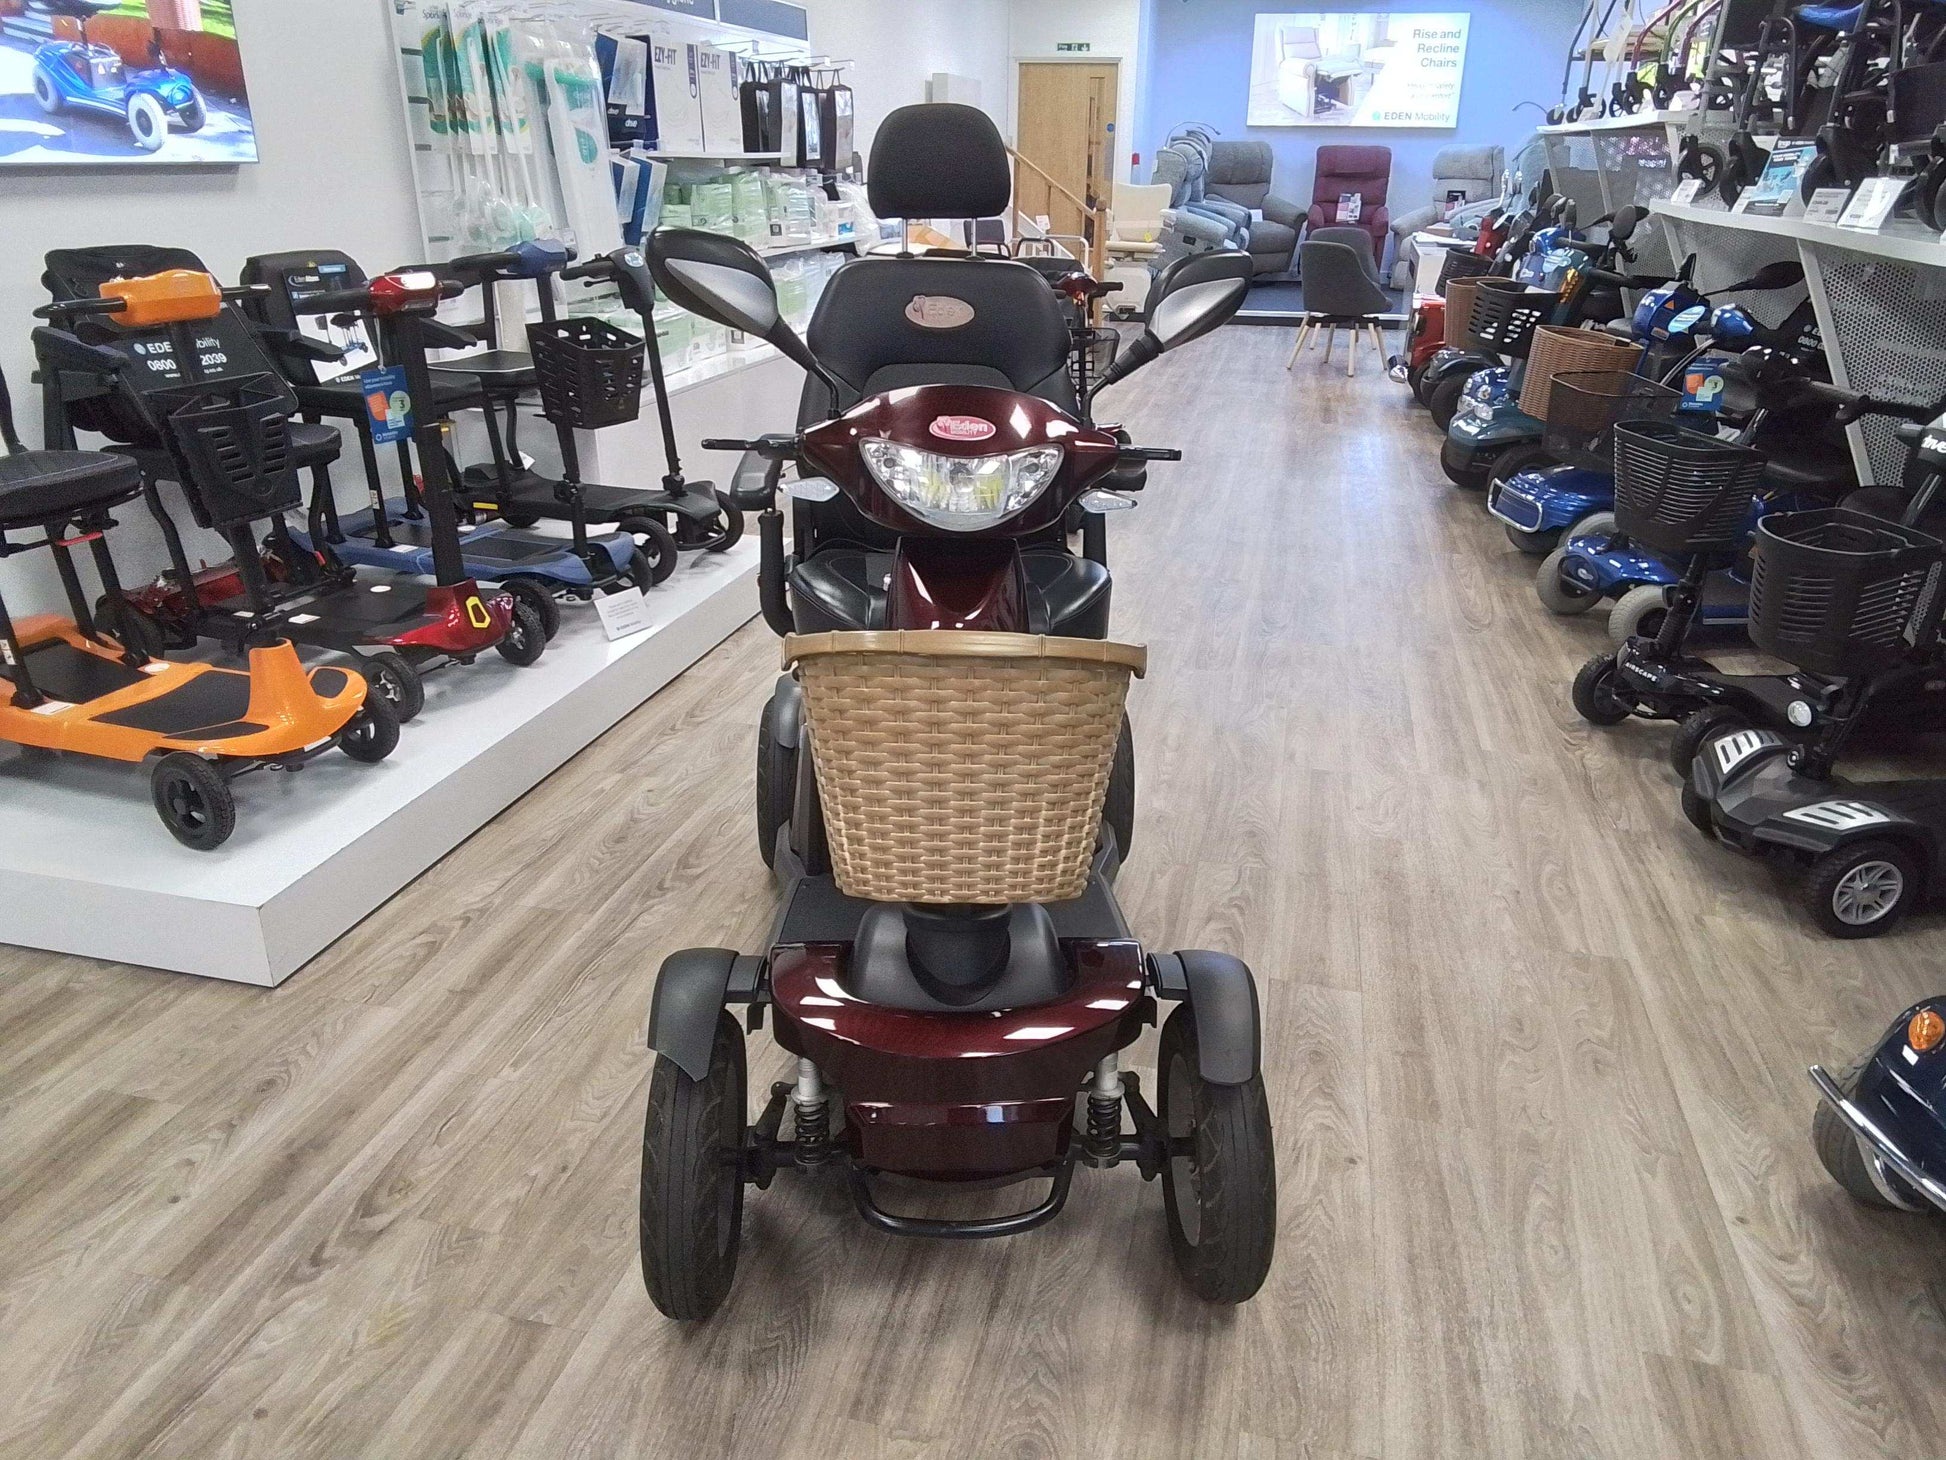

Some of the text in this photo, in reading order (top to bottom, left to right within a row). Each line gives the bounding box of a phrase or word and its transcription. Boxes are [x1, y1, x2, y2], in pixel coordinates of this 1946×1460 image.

[1412, 28, 1462, 39] Rise and
[1417, 43, 1460, 54] Recline
[1420, 57, 1458, 68] Chairs
[1383, 111, 1450, 123] EDEN Mobility
[146, 337, 221, 354] EDE bility
[146, 352, 228, 371] 0800 2039
[951, 420, 988, 431] Eden
[1625, 662, 1658, 682] AIRSCAPE
